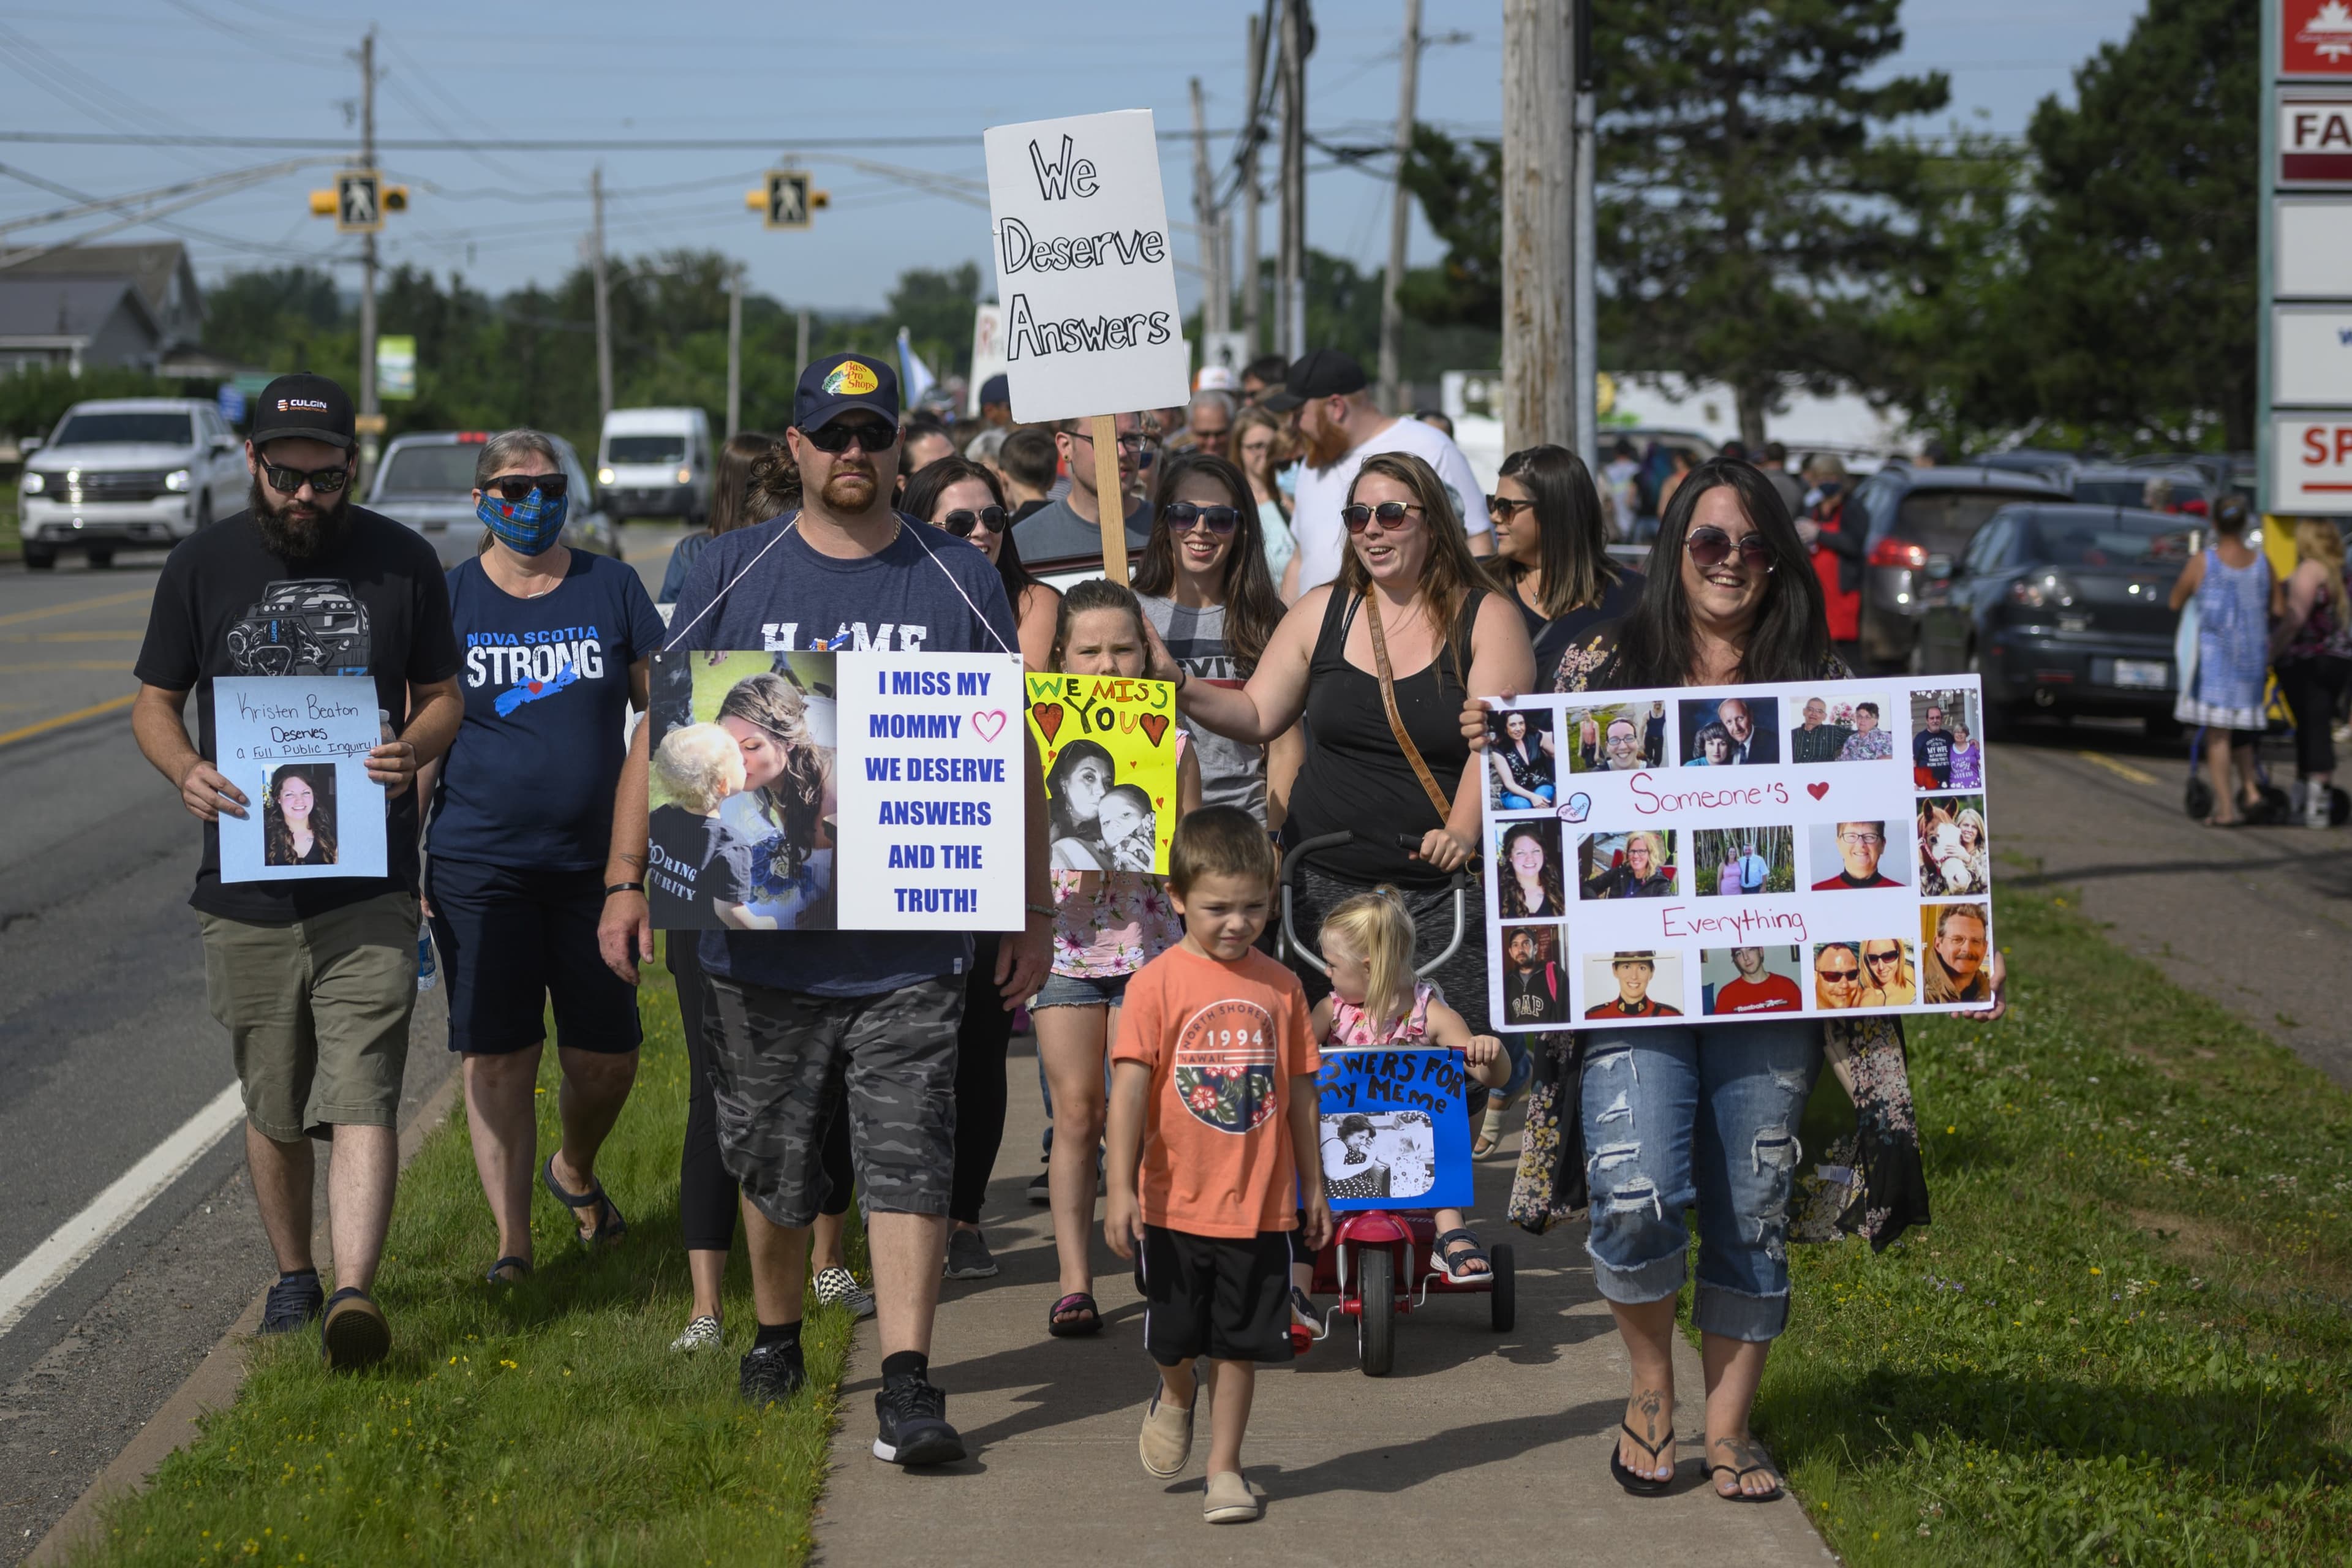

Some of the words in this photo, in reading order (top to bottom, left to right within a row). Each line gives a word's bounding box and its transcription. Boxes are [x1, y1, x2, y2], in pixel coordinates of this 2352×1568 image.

[1028, 134, 1100, 201] We
[1000, 217, 1165, 274] Deserve
[1007, 293, 1170, 361] Answers
[845, 362, 867, 372] Bass
[847, 371, 863, 380] Pro
[848, 380, 875, 390] Shops
[290, 399, 327, 409] CULGIN
[467, 631, 519, 647] NOVA
[524, 625, 599, 644] SCOTIA
[467, 639, 604, 688] STRONG
[878, 671, 886, 695] I
[892, 671, 951, 696] MISS
[957, 672, 990, 696] MY
[1030, 677, 1082, 698] WE
[1091, 680, 1168, 709] MISS
[237, 692, 299, 723] Kristen
[306, 693, 358, 720] Beaton
[1063, 695, 1138, 734] YOU
[271, 726, 328, 743] Deserves
[869, 714, 962, 739] MOMMY
[254, 746, 273, 757] Full
[282, 743, 321, 755] Public
[865, 758, 901, 782] WE
[907, 758, 1005, 783] DESERVE
[1630, 772, 1789, 815] Someone's
[878, 801, 992, 826] ANSWERS
[888, 845, 935, 869] AND
[941, 845, 983, 869] THE
[894, 889, 978, 913] TRUTH!
[1662, 907, 1808, 944] Everything
[1184, 1011, 1215, 1049] NORTH
[1219, 1005, 1261, 1019] SHORE
[1207, 1029, 1263, 1047] 1994
[1316, 1052, 1417, 1082] SWERS
[1421, 1056, 1464, 1099] FOR
